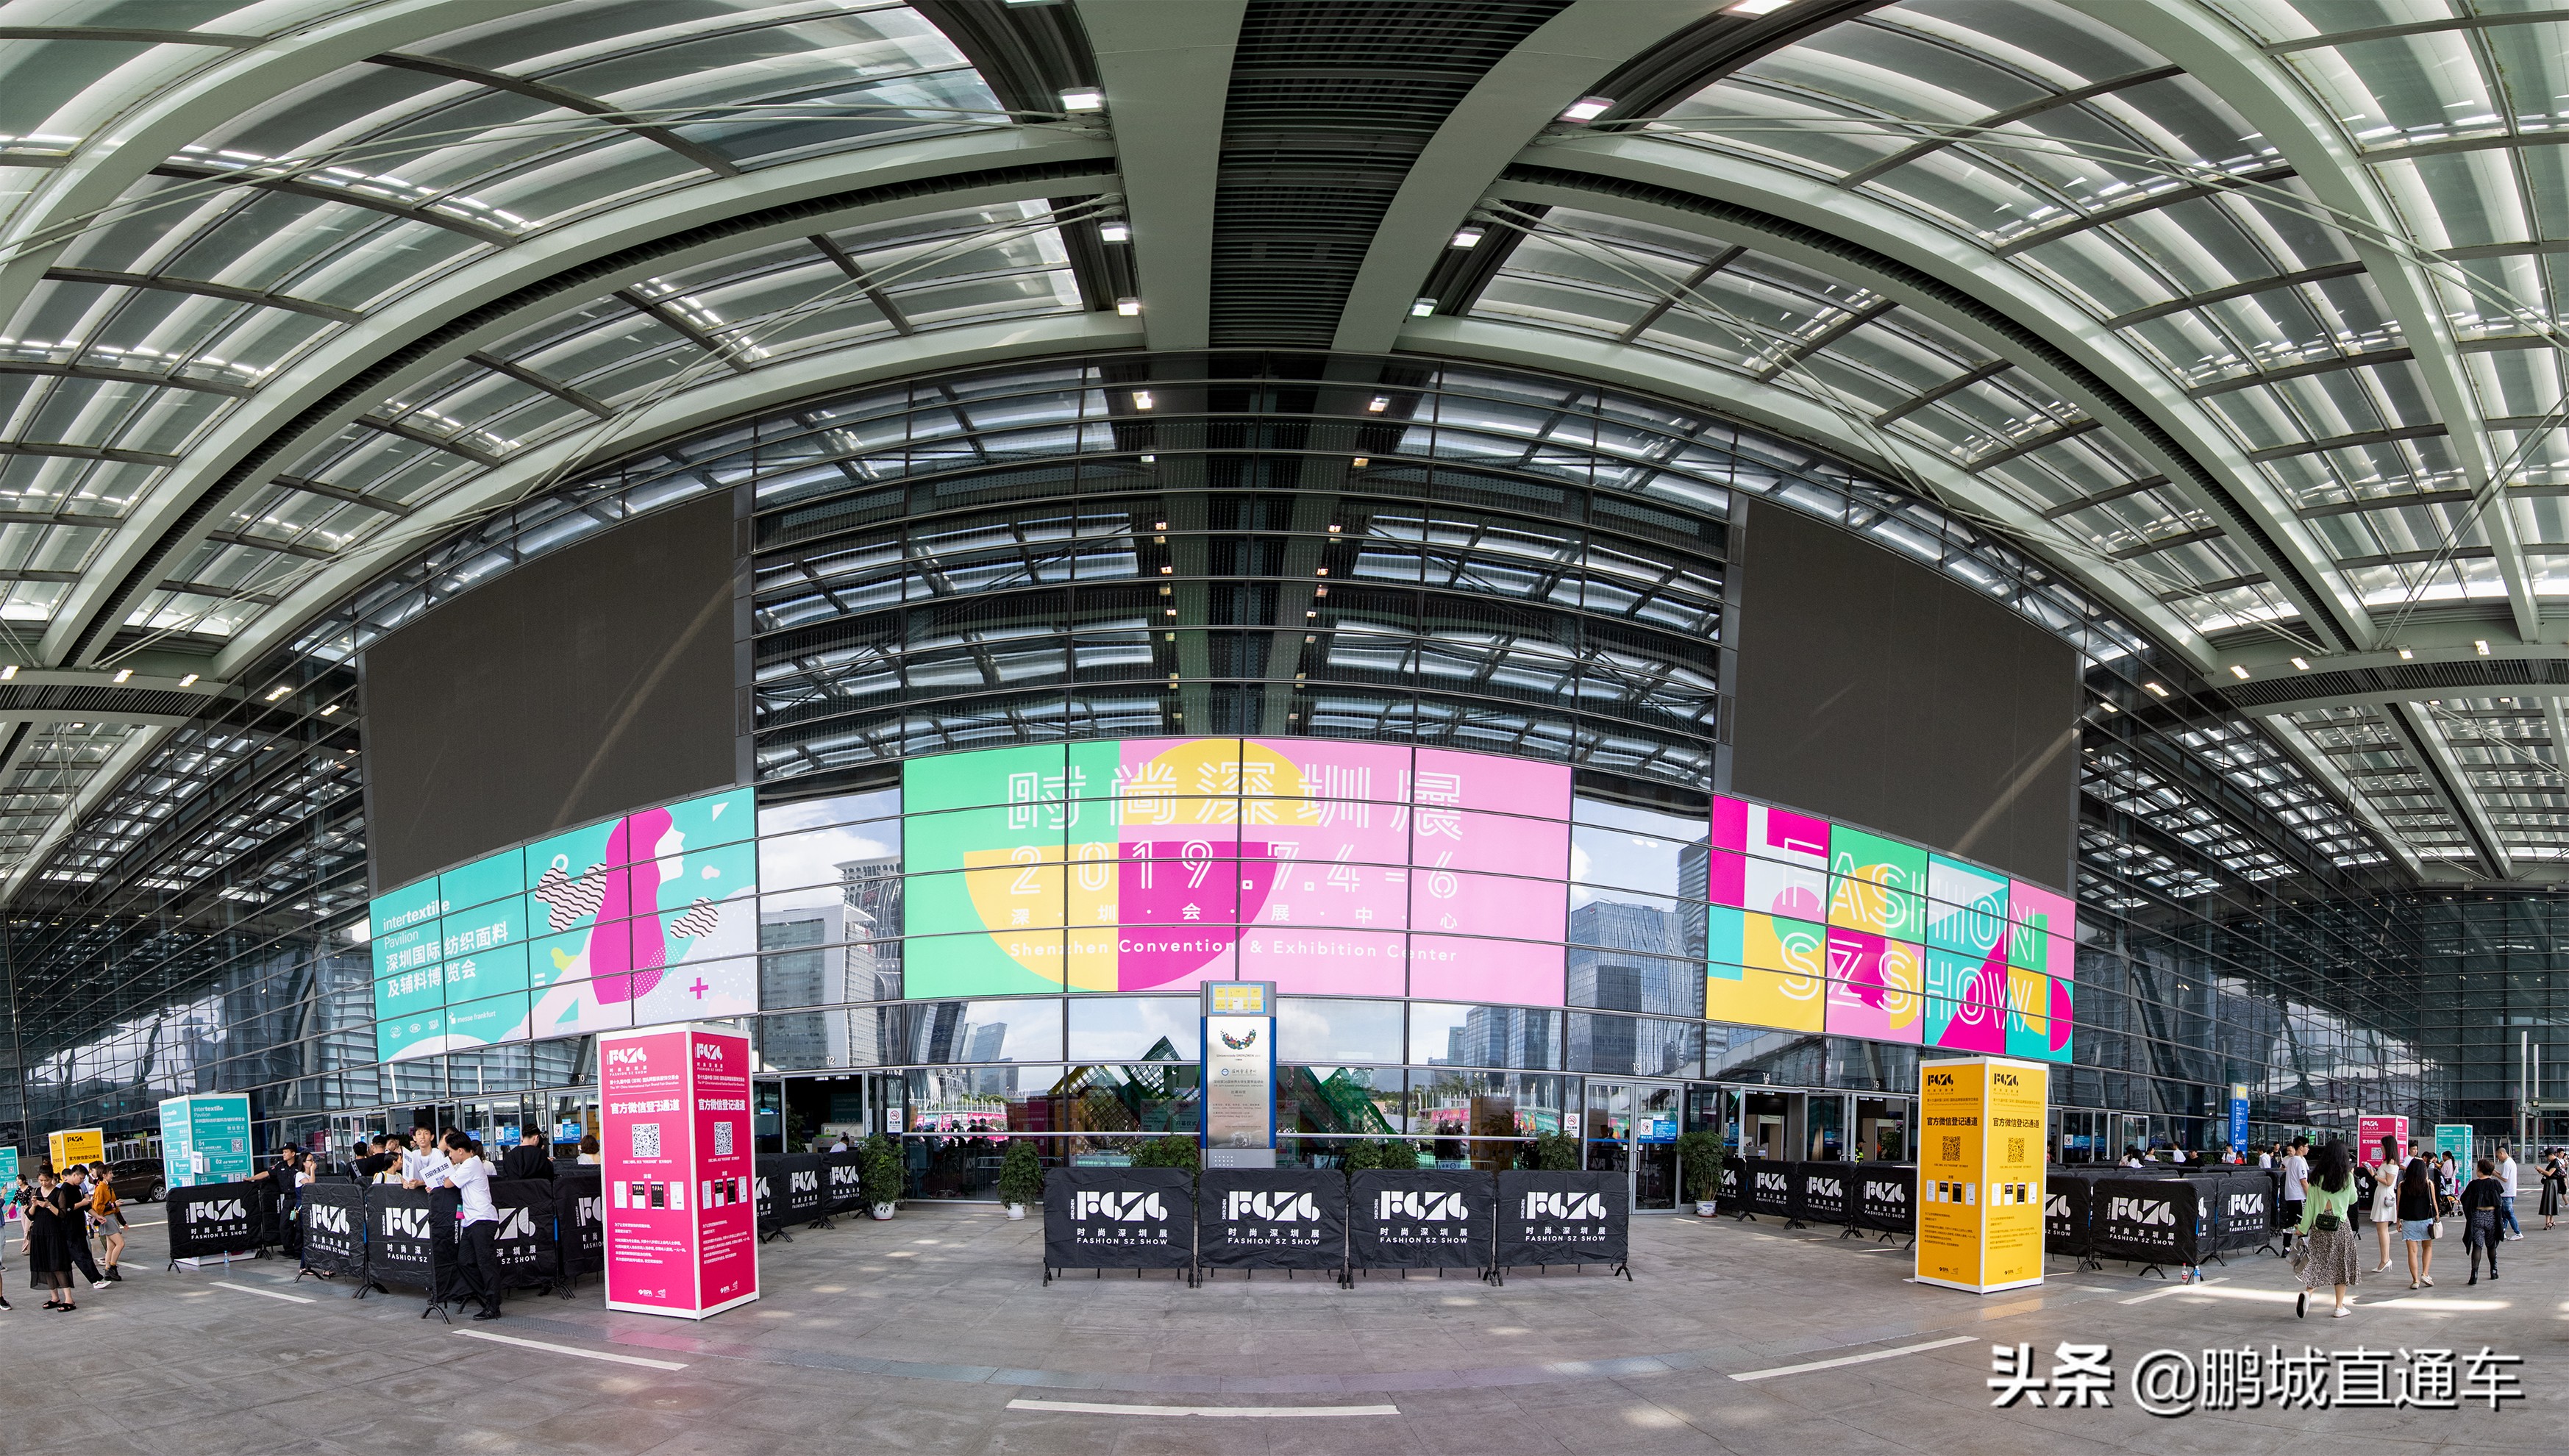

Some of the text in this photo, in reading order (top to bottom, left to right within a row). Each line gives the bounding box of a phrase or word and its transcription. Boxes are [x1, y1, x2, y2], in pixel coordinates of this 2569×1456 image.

[1008, 762, 1464, 841] 时尚深圳展
[1781, 838, 2036, 963] FASHION
[383, 900, 450, 932] intertextile
[385, 931, 418, 949] Pavilion
[386, 921, 508, 973] 深圳国际纺织面料
[1010, 938, 1457, 963] Shenzhen Convention & Exhibition Center
[388, 959, 476, 999] 及辅料博览会
[1778, 932, 2033, 1032] SZ SHOW
[474, 1010, 496, 1020] frankfurt
[826, 1056, 835, 1065] 12
[578, 1074, 585, 1082] 10
[1762, 1072, 1770, 1081] 14
[698, 1099, 746, 1111] 官方微信登记通道
[1927, 1117, 1978, 1126] 官方微信登记通道
[1993, 1118, 2039, 1128] 官方微信登记通道
[385, 1207, 430, 1238] FSZ
[1077, 1227, 1168, 1238] 时尚深圳展
[1228, 1227, 1319, 1238] 时尚深圳展
[1380, 1227, 1468, 1237] 时尚深圳展
[1525, 1226, 1606, 1235] 时尚深圳展
[2109, 1227, 2175, 1241] 时尚深圳展
[2109, 1233, 2139, 1242] FASHION
[387, 1243, 431, 1255] 时尚深
[583, 1241, 603, 1249] FASHIO
[496, 1245, 536, 1257] 深圳展
[388, 1253, 416, 1262] FASHION
[515, 1255, 536, 1263] SHOW
